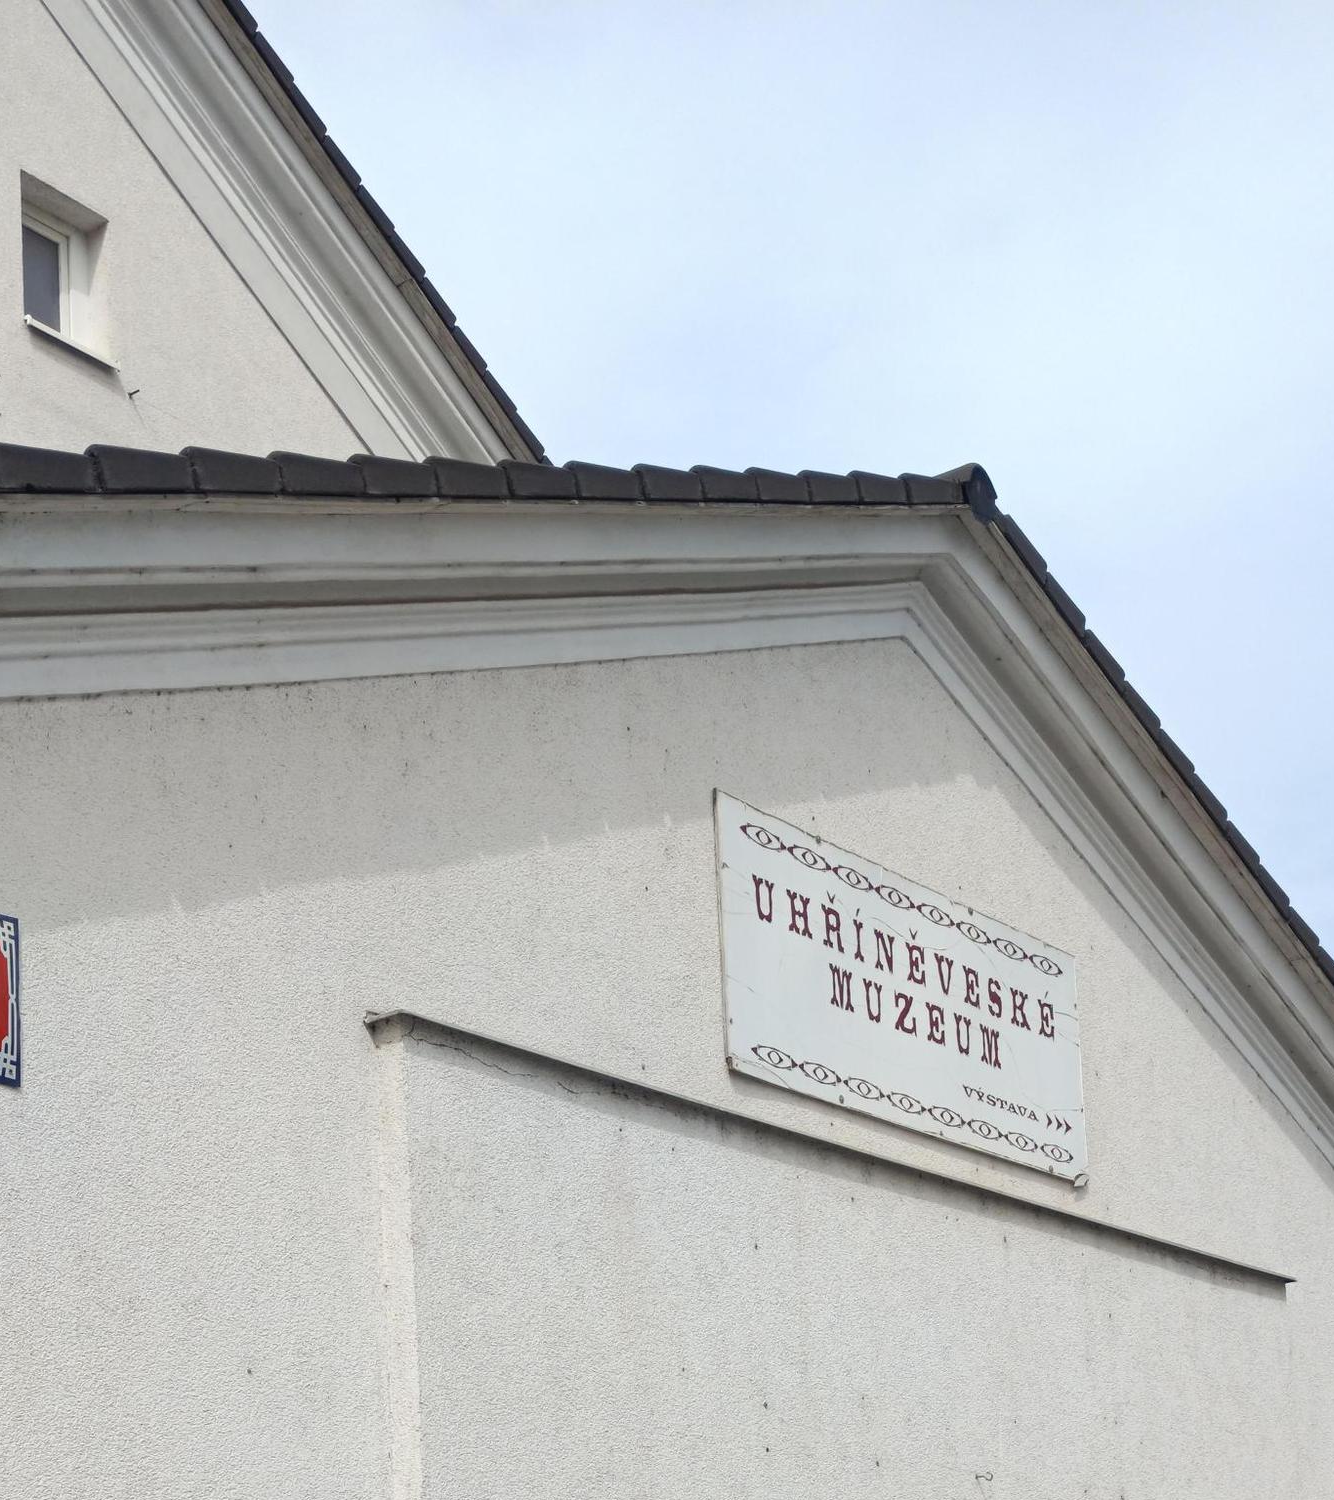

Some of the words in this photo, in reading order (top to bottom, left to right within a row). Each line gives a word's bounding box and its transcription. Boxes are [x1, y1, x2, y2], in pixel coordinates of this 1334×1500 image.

[752, 873, 1056, 1040] UHŘÍNĚVESKÉ
[829, 963, 1002, 1070] MUZEUM
[962, 1084, 1039, 1122] VÝSTAVA
